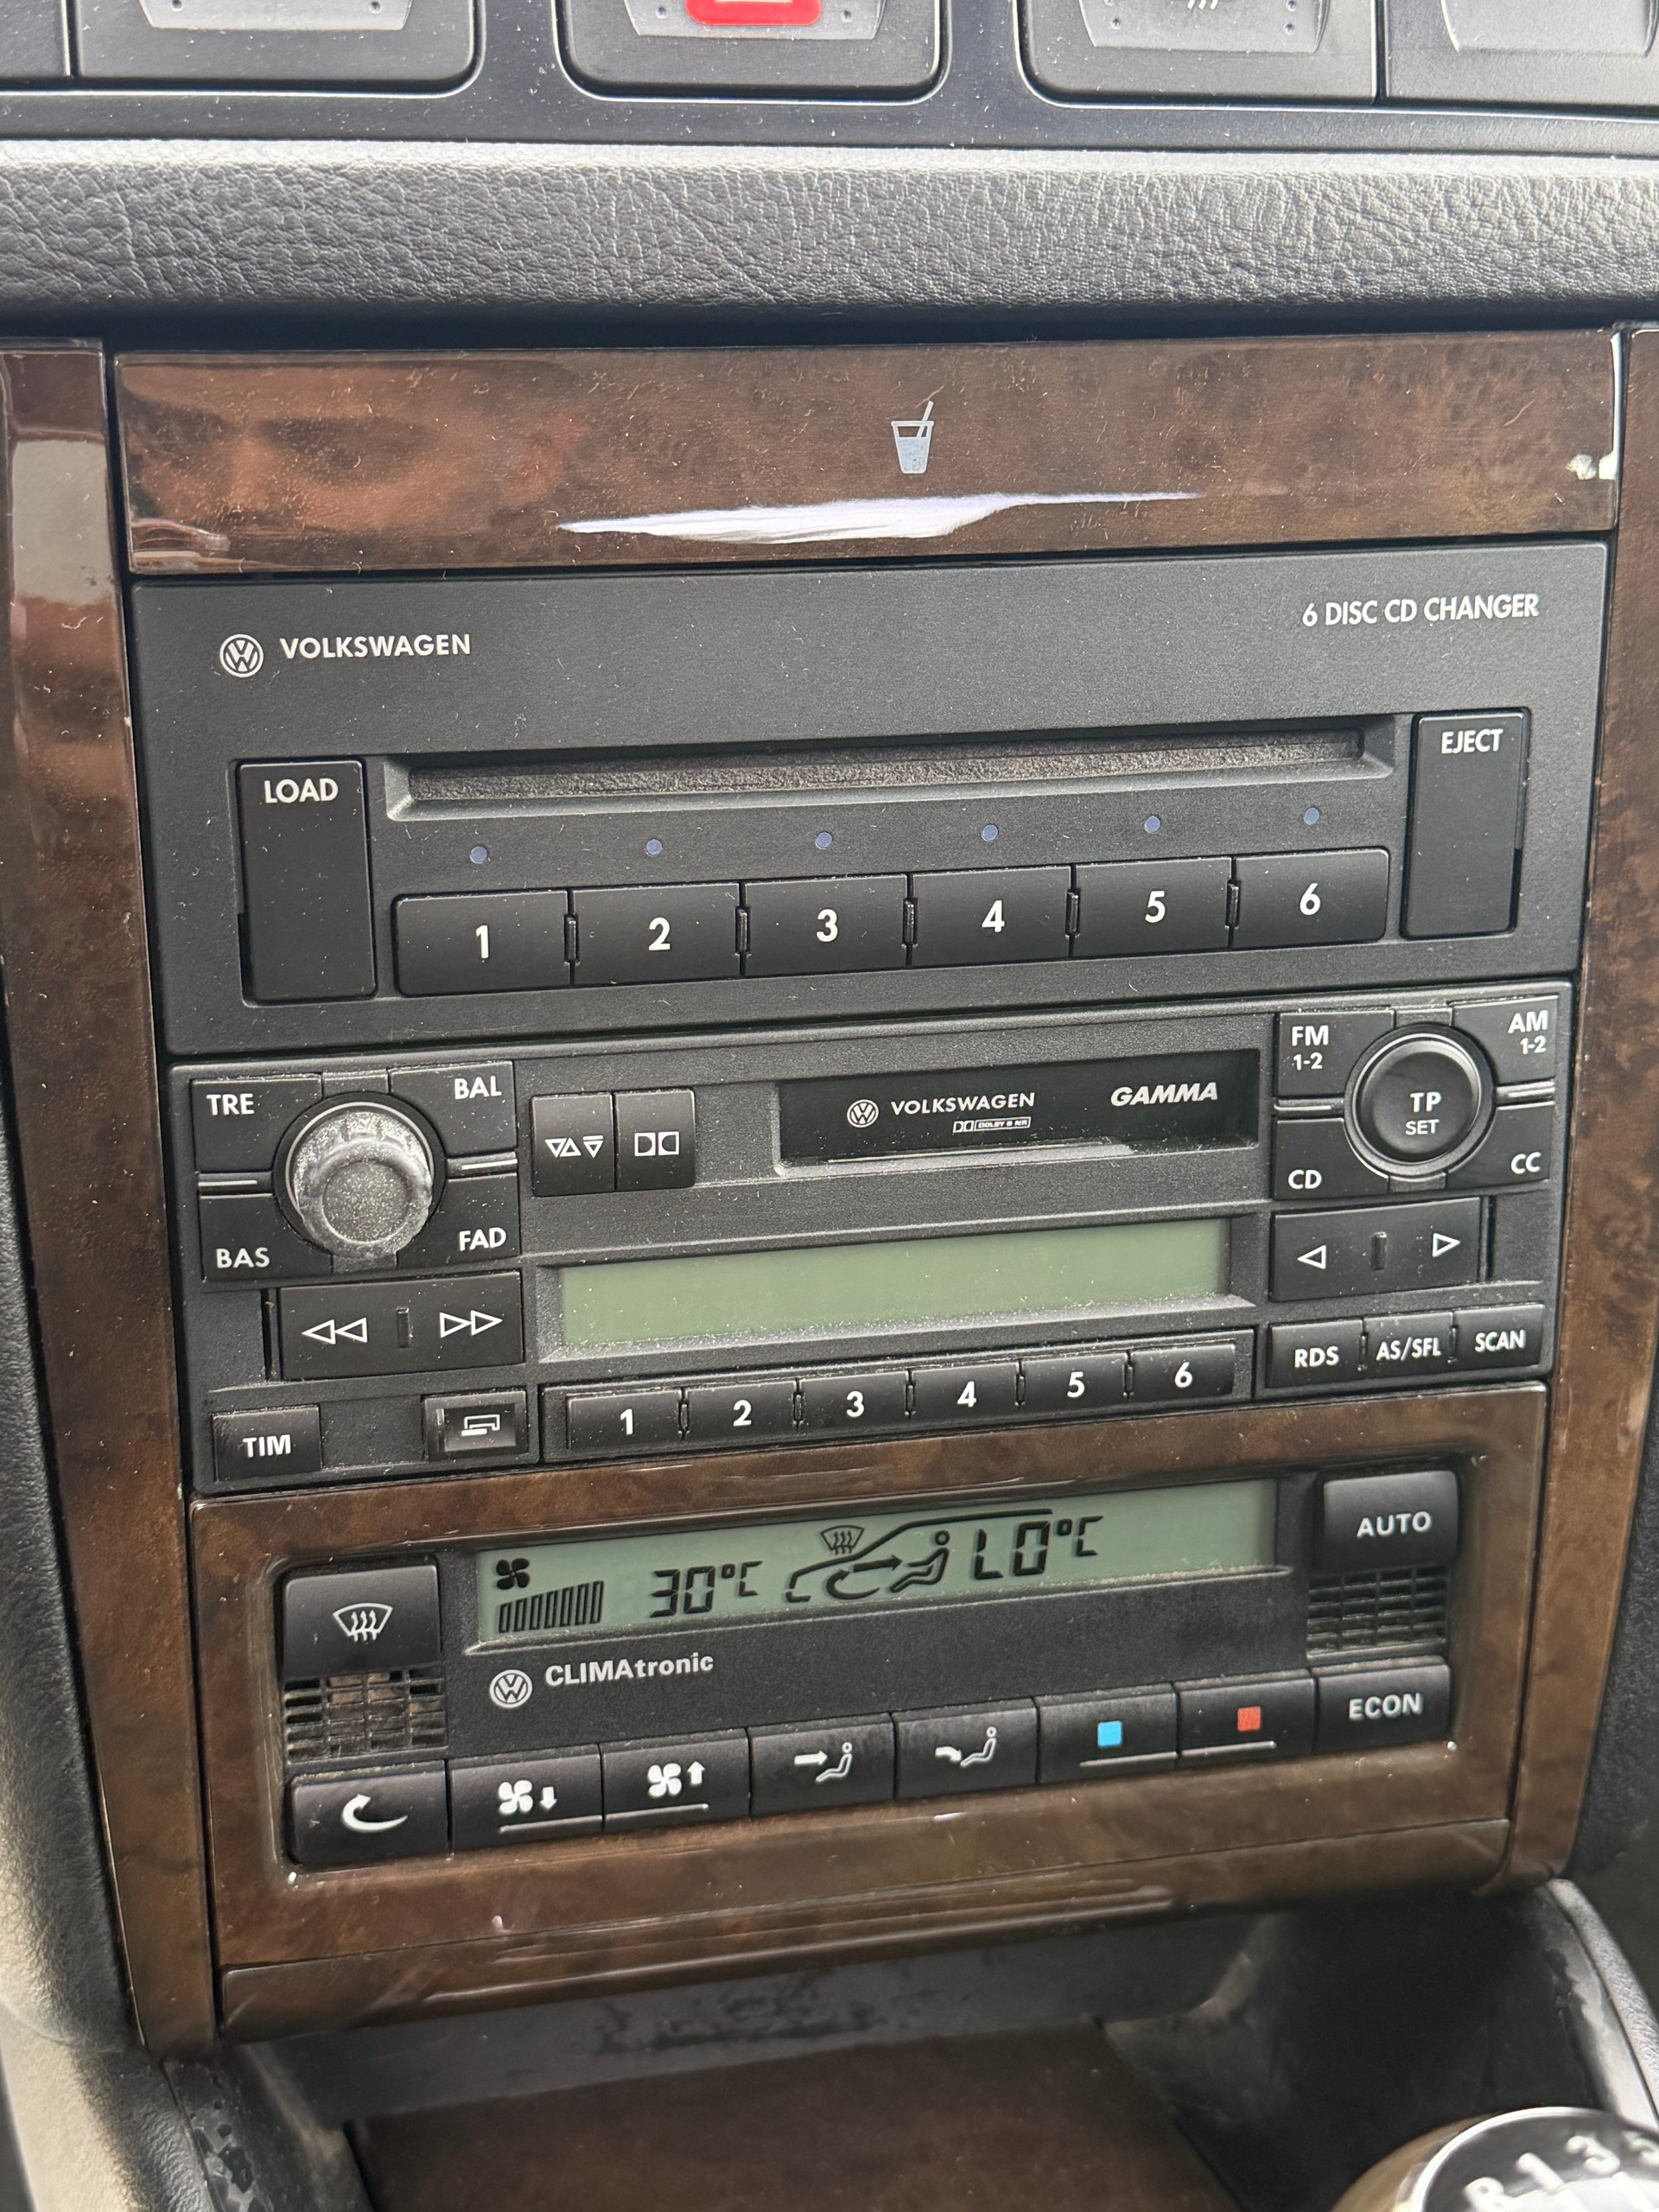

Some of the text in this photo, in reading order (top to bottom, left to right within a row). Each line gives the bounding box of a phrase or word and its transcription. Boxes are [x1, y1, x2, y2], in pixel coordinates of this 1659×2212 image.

[1302, 593, 1539, 627] 6 DISC CD CHANGER
[279, 633, 471, 659] VOLKSWAGEN
[1441, 728, 1504, 754] EJECT
[264, 778, 339, 804] LOAD
[475, 882, 1321, 959] 1 2 3 4 5 6
[1508, 1009, 1549, 1034] AM
[1292, 1025, 1329, 1046] FM
[1520, 1034, 1547, 1055] 1-2
[1293, 1052, 1323, 1071] 1-2
[454, 1075, 502, 1100] BAL
[1110, 1082, 1218, 1107] GAMMA
[206, 1093, 255, 1116] TRE
[890, 1091, 1036, 1116] VOLKSWAGEN
[1409, 1091, 1442, 1113] TP
[1405, 1118, 1440, 1135] SET
[1510, 1151, 1541, 1174] CC
[1287, 1169, 1322, 1190] CD
[459, 1227, 506, 1252] FAD
[216, 1247, 270, 1268] BAS
[1376, 1336, 1441, 1361] AS/SFL
[1474, 1329, 1526, 1352] SCAN
[1294, 1345, 1339, 1369] RDS
[620, 1361, 1193, 1435] 1 2 3 4 5 6
[242, 1433, 291, 1458] TIM
[1357, 1511, 1432, 1538] AUTO
[544, 1651, 714, 1687] CLIMAtronic
[1349, 1692, 1421, 1720] ECON
